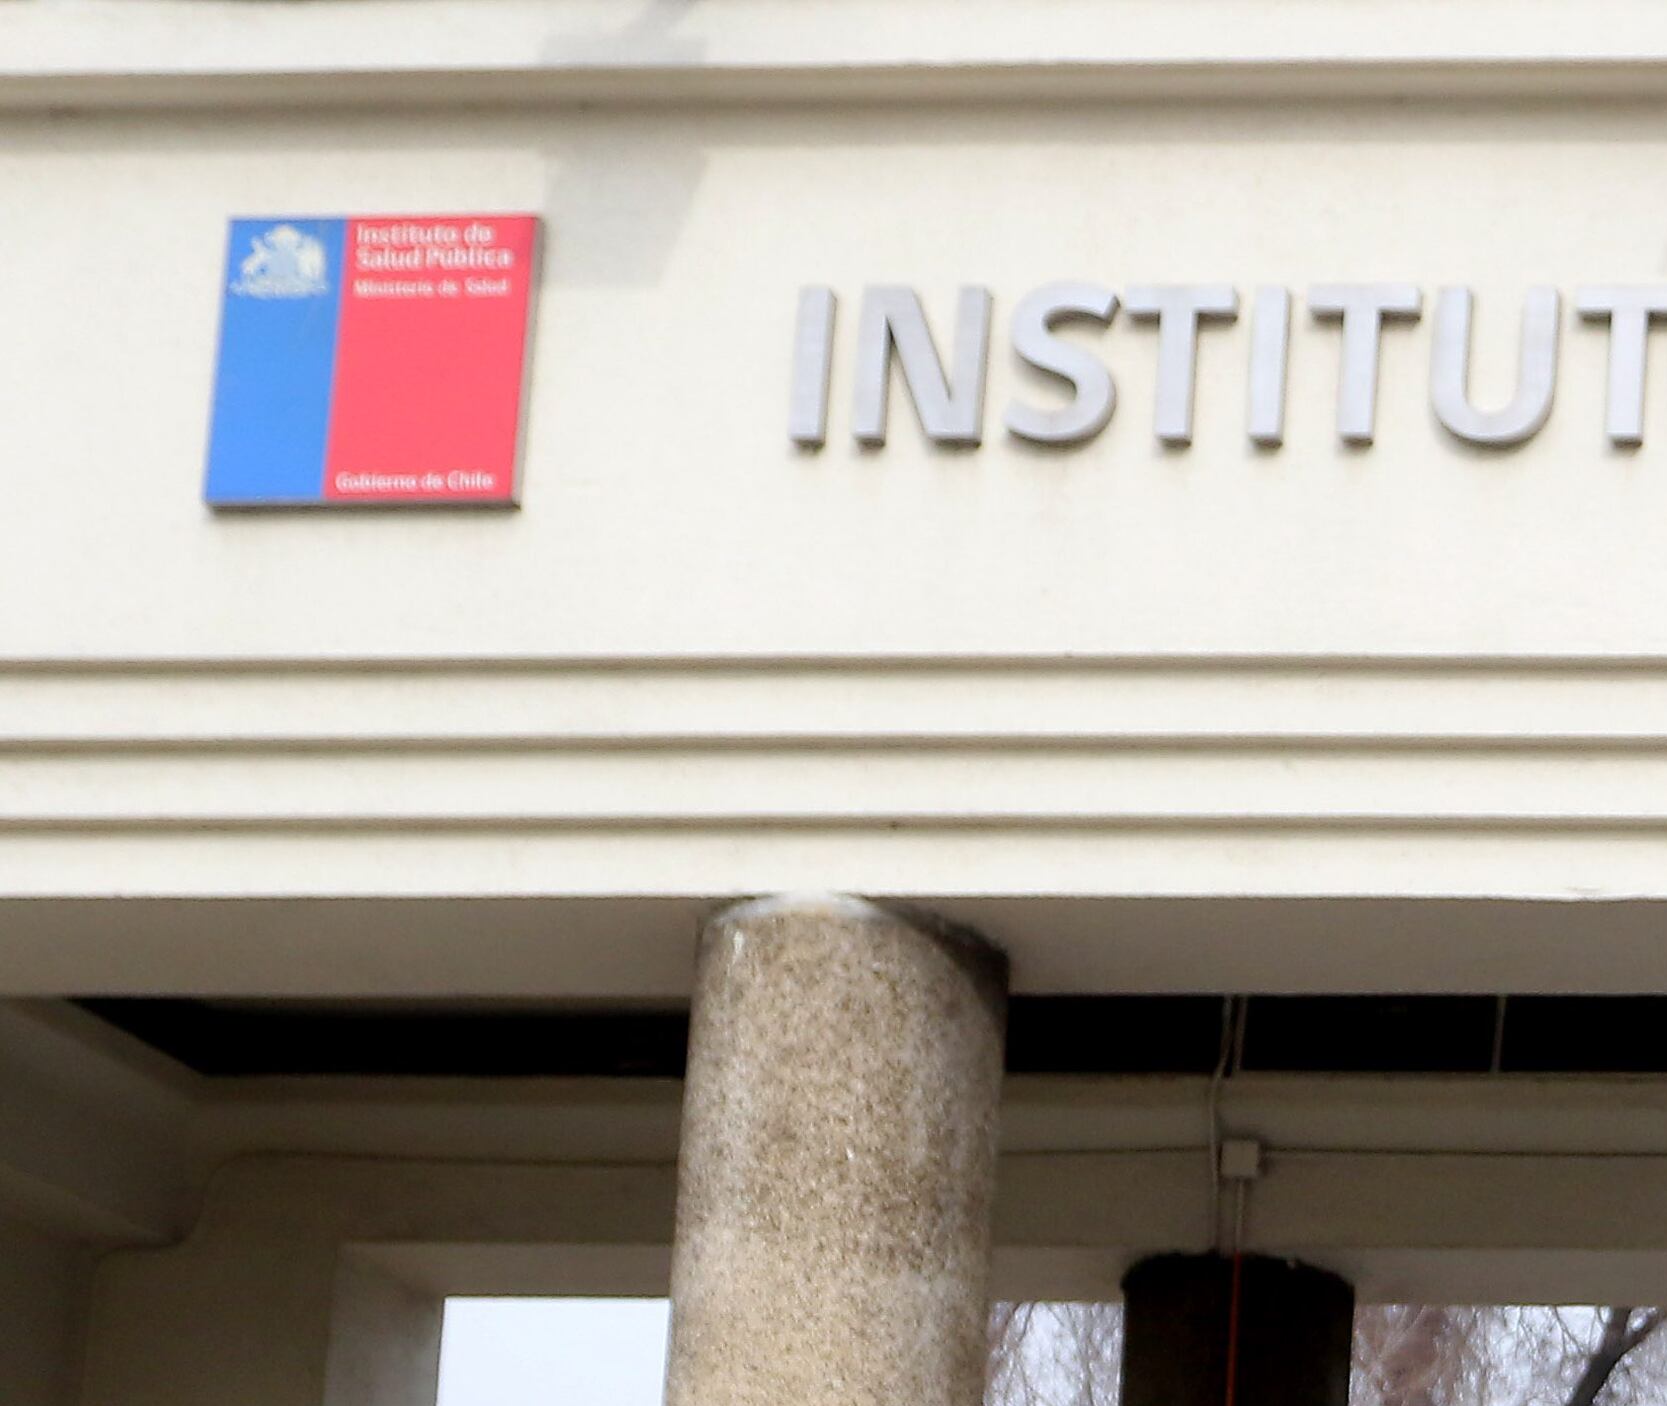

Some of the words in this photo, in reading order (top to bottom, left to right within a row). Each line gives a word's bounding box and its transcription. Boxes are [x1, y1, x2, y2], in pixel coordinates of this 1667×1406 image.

[357, 223, 458, 245] Instituto
[464, 222, 495, 245] de
[356, 245, 424, 271] Salud
[335, 470, 418, 492] Gobierno
[421, 471, 445, 490] de
[447, 470, 495, 490] Chile
